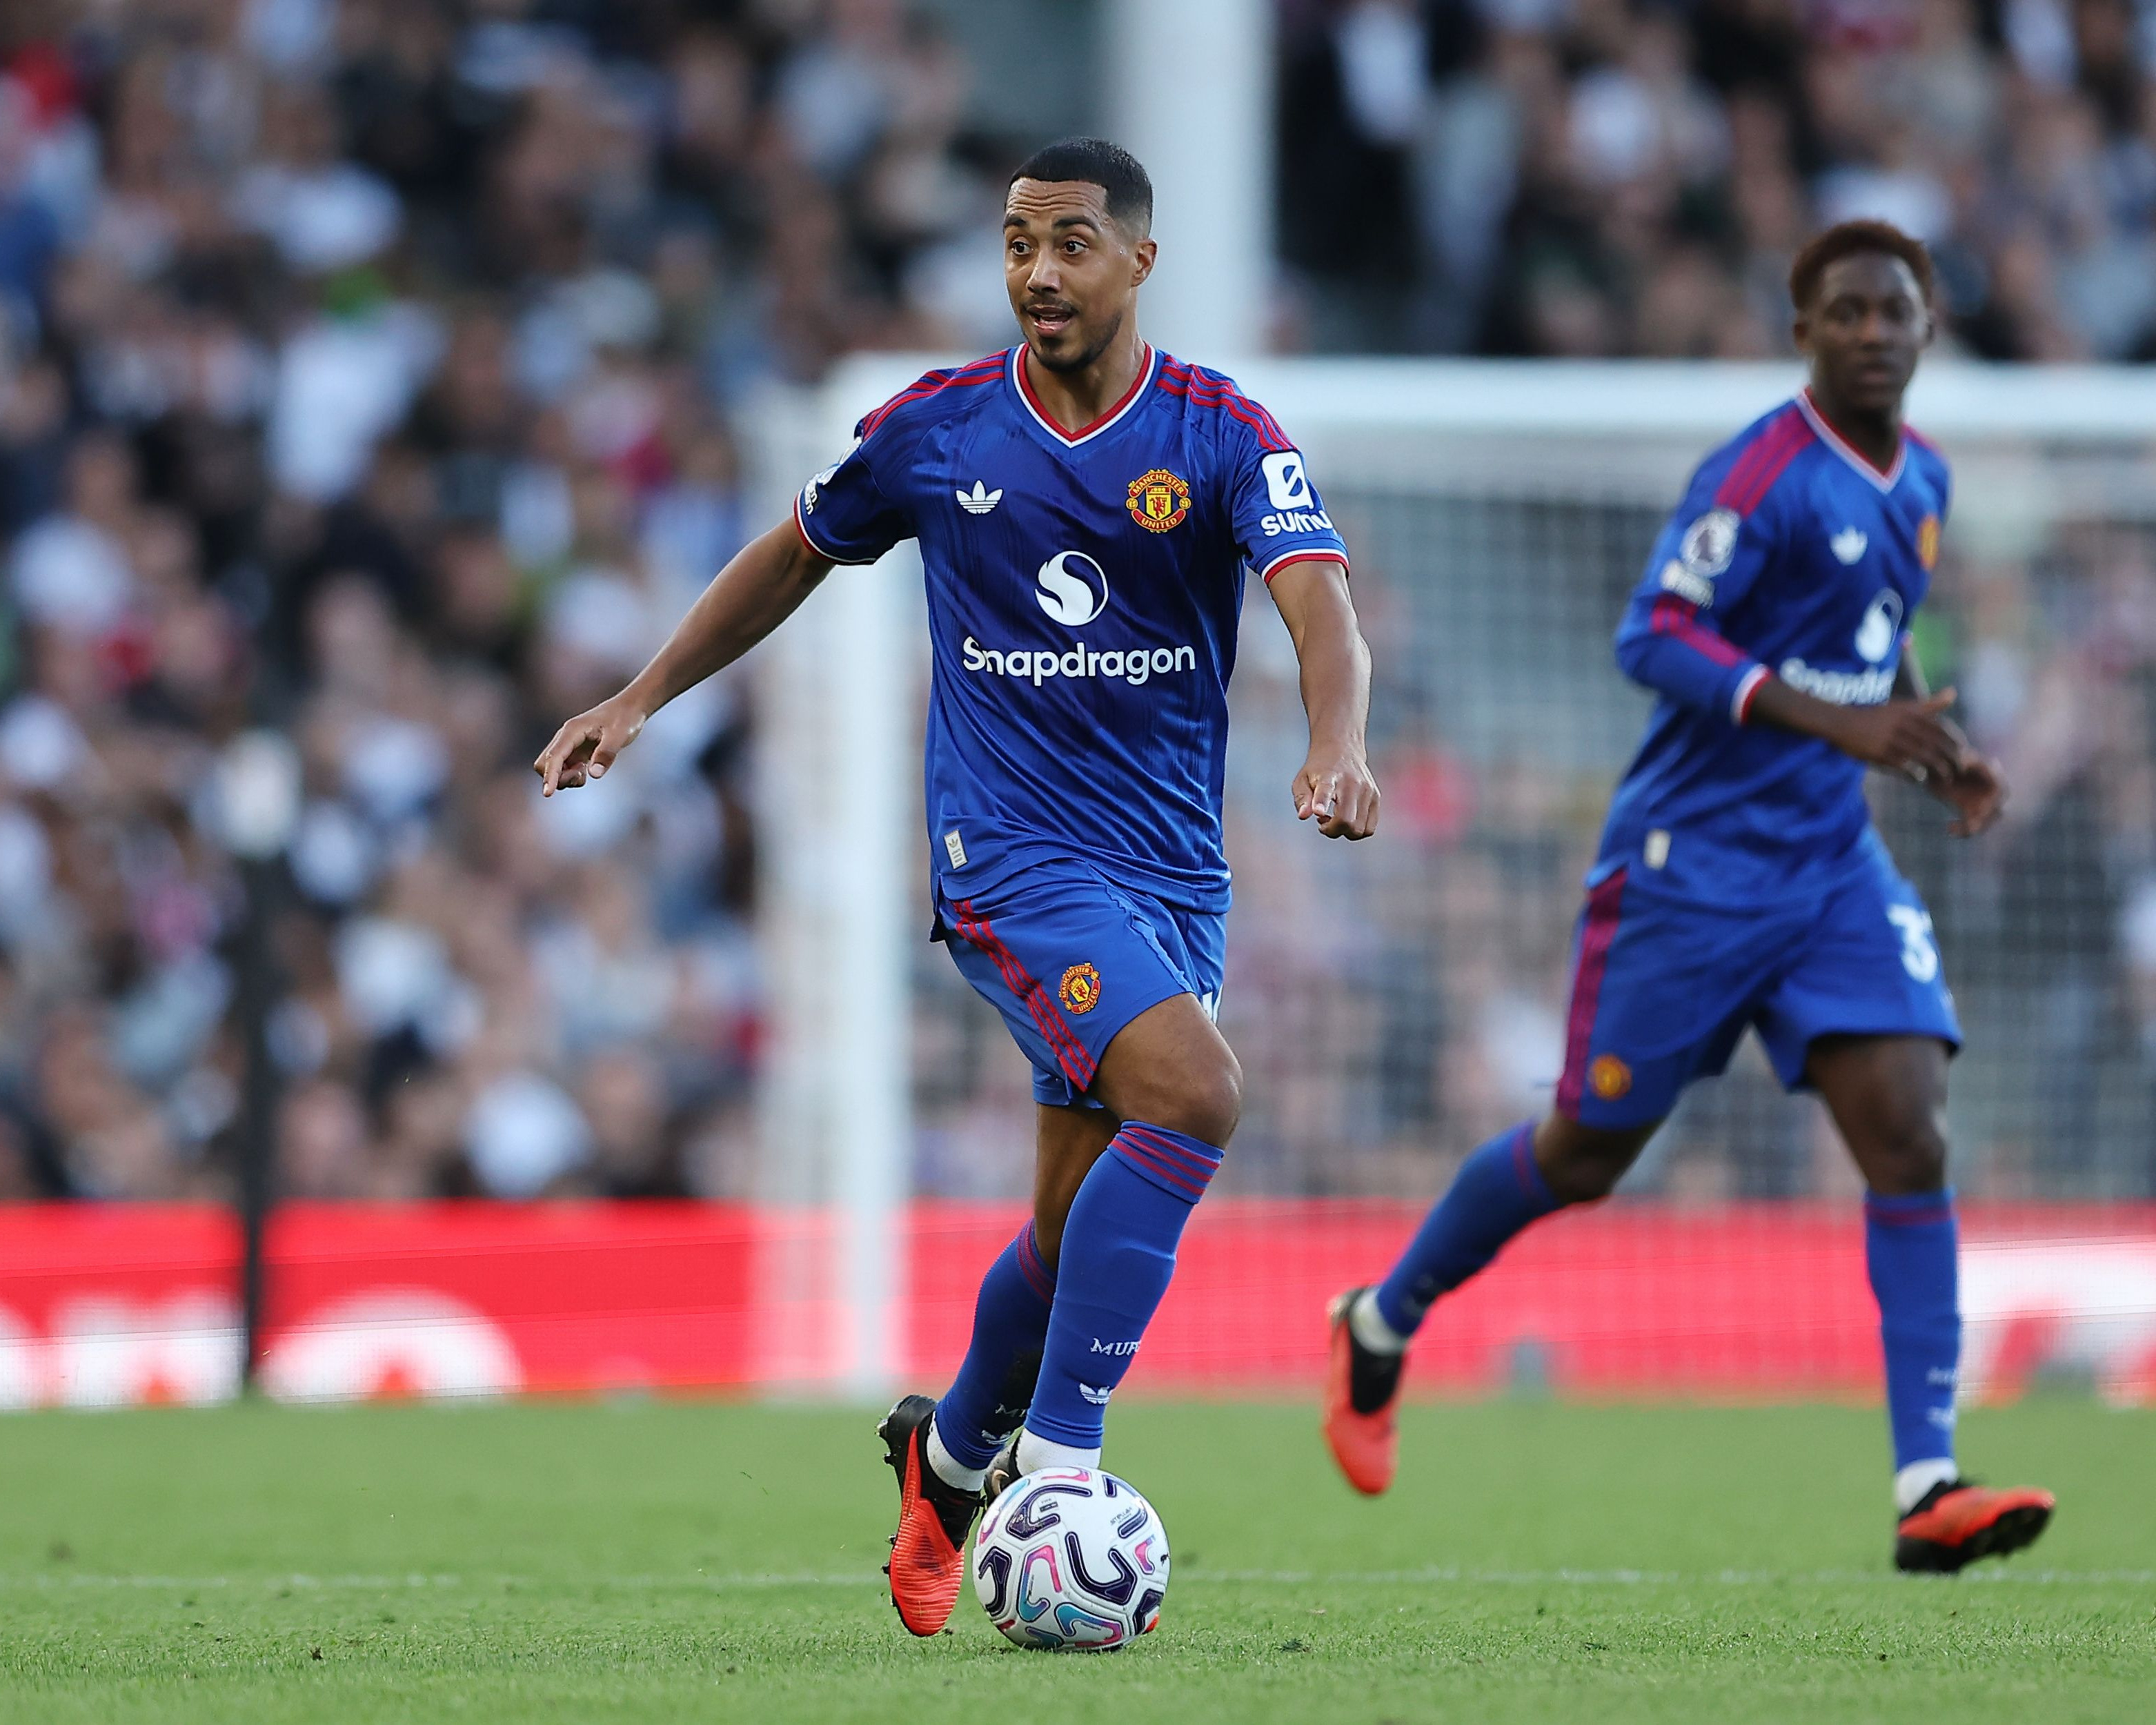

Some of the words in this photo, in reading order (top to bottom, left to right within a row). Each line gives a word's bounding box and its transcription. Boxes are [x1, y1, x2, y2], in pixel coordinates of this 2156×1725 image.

[1132, 473, 1184, 494] MANCHESTER
[1141, 518, 1177, 529] UNITED
[1260, 510, 1338, 536] sumu
[963, 635, 1196, 687] Snapdragon
[1062, 967, 1089, 998] MANCHESTER
[1078, 988, 1098, 1012] UNITED
